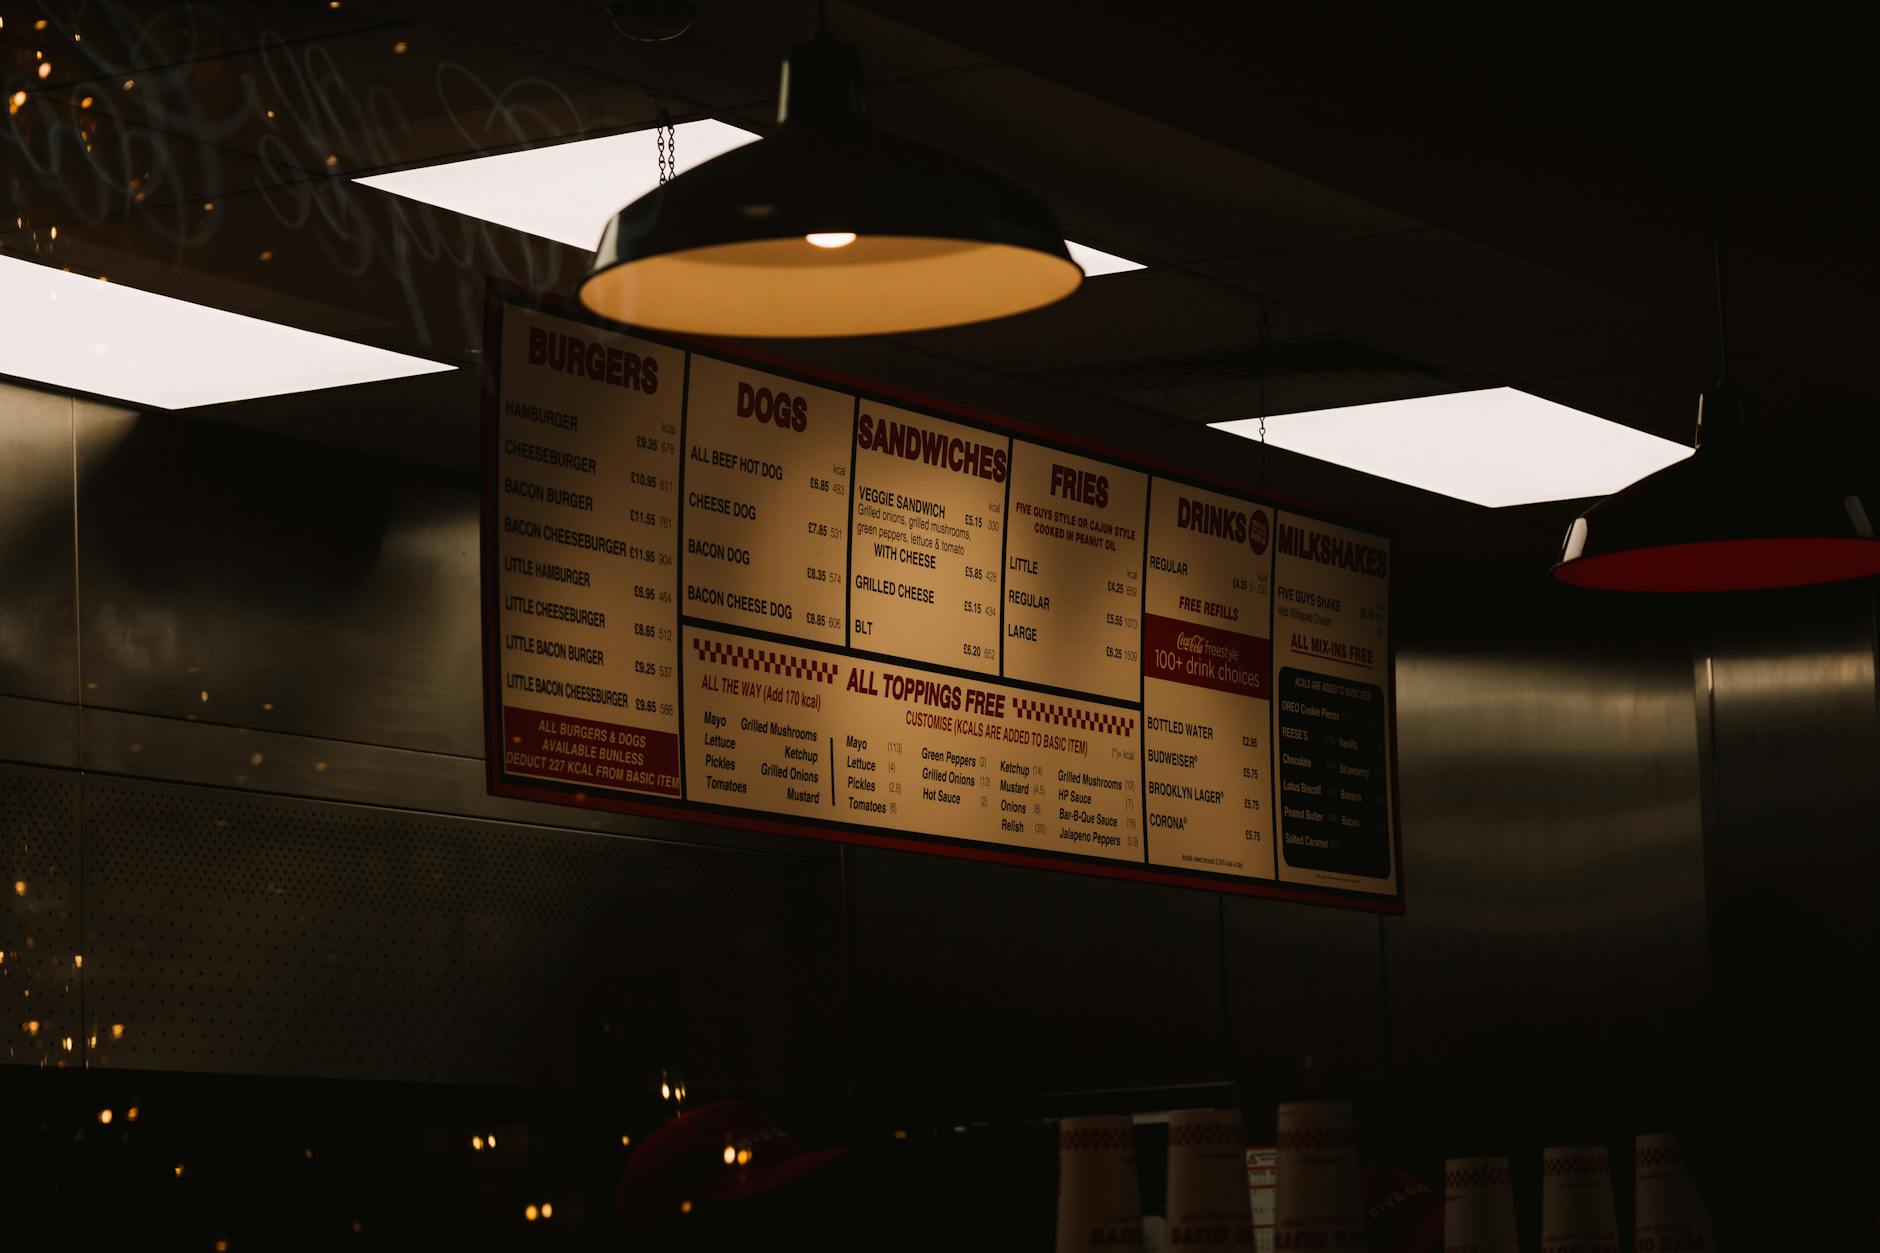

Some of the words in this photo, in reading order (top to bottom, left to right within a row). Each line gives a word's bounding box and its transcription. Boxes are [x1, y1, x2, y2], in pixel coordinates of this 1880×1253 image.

[529, 327, 658, 394] BURGERS
[505, 400, 577, 431] HAMBURGER
[737, 381, 807, 432] DOGS
[505, 439, 596, 474] CHEESEBURGER
[858, 414, 1006, 483] SANDWICHES
[691, 446, 709, 464] ALL
[712, 451, 737, 468] BEEF
[740, 456, 759, 474] HOT
[762, 462, 782, 480] DOG
[505, 478, 543, 500] BACON
[547, 488, 593, 511] BURGER
[1051, 464, 1108, 509] FRIES
[689, 492, 730, 515] CHEESE
[734, 503, 756, 520] DOG
[859, 485, 894, 507] VEGGIE
[897, 495, 945, 519] SANDWICH
[858, 504, 880, 519] Grilled
[883, 509, 906, 526] onions,
[908, 514, 929, 531] grilled
[931, 520, 971, 542] mushrooms,
[965, 514, 982, 528] £5.15
[1016, 503, 1032, 515] FIVE
[1034, 506, 1052, 520] GUYS
[1054, 511, 1076, 526] STYLE
[1078, 516, 1088, 529] OR
[1090, 519, 1112, 535] CAJUN
[1114, 524, 1135, 540] STYLE
[1178, 497, 1247, 544] DRINKS
[504, 517, 541, 539] BACON
[544, 525, 626, 556] CHEESEBURGER
[857, 522, 877, 537] green
[879, 526, 908, 544] peppers,
[911, 532, 932, 549] lettuce
[935, 538, 940, 549] &
[942, 539, 964, 556] tomato
[1034, 522, 1065, 540] COOKED
[1067, 529, 1074, 542] IN
[1076, 532, 1103, 549] PEANUT
[1106, 538, 1116, 551] OIL
[630, 547, 654, 562] £11.95
[688, 538, 724, 560] BACON
[728, 548, 750, 565] DOG
[874, 543, 897, 561] WITH
[900, 548, 936, 569] CHEESE
[1279, 524, 1386, 578] MILKSHAKES
[505, 556, 533, 576] LITTLE
[536, 563, 590, 587] HAMBURGER
[1010, 556, 1038, 574] LITTLE
[1150, 556, 1187, 576] REGULAR
[856, 575, 895, 595] GRILLED
[898, 583, 934, 604] CHEESE
[1108, 581, 1123, 594] £4.25
[1278, 586, 1293, 601] FIVE
[1296, 590, 1314, 606] GUYS
[1317, 594, 1340, 612] SHAKE
[688, 585, 723, 606] BACON
[727, 594, 767, 615] CHEESE
[771, 602, 792, 619] DOG
[1009, 589, 1050, 610] REGULAR
[1179, 596, 1201, 612] FREE
[1204, 600, 1238, 622] REFILLS
[505, 595, 533, 615] LITTLE
[536, 600, 605, 628] CHEESEBURGER
[856, 619, 872, 636] BLT
[1008, 624, 1037, 642] LARGE
[506, 634, 535, 653] LITTLE
[537, 639, 566, 659] BACON
[569, 646, 604, 666] BURGER
[964, 643, 980, 657] £6.20
[1205, 639, 1239, 662] freestyle
[1292, 633, 1308, 650] ALL
[1312, 637, 1346, 659] MIX-INS
[1350, 647, 1373, 664] FREE
[1155, 649, 1183, 671] 100+
[1186, 656, 1215, 680] drink
[1218, 664, 1260, 688] choices
[507, 672, 533, 691] LITTLE
[536, 678, 563, 697] BACON
[566, 682, 628, 708] CHEESEBURGER
[702, 674, 718, 692] ALL
[722, 678, 738, 695] THE
[742, 682, 761, 698] WAY
[764, 684, 783, 703] (Add
[786, 690, 799, 706] 170
[802, 692, 821, 712] kcal)
[847, 668, 877, 696] ALL
[883, 674, 961, 710] TOPPINGS
[966, 690, 1005, 718] FREE
[704, 712, 726, 728] Mayo
[1282, 701, 1299, 713] OREO
[1301, 704, 1319, 717] Cookie
[1321, 707, 1340, 721] Pieces
[538, 719, 556, 734] ALL
[560, 722, 607, 743] BURGERS
[609, 731, 616, 743] &
[618, 732, 646, 748] DOGS
[741, 718, 768, 733] Grilled
[770, 722, 817, 741] Mushrooms
[906, 711, 952, 732] CUSTOMISE
[954, 718, 983, 737] (KCALS
[986, 724, 1001, 740] ARE
[1004, 729, 1030, 746] ADDED
[1032, 733, 1041, 747] TO
[1043, 735, 1066, 751] BASIC
[1068, 738, 1088, 758] ITEM)
[1148, 717, 1183, 735] BOTTLED
[1186, 723, 1213, 740] WATER
[542, 738, 598, 759] AVAILABLE
[599, 746, 644, 766] BUNLESS
[705, 734, 735, 750] Lettuce
[846, 736, 867, 750] Mayo
[706, 754, 735, 770] Pickles
[785, 746, 818, 765] Ketchup
[847, 756, 876, 771] Lettuce
[922, 747, 944, 761] Green
[946, 752, 976, 767] Peppers
[1283, 753, 1312, 767] Chocolate
[506, 752, 546, 769] DEDUCT
[550, 758, 565, 771] 227
[568, 760, 593, 776] KCAL
[596, 764, 624, 781] FROM
[627, 769, 654, 785] BASIC
[658, 774, 680, 789] ITEM
[761, 763, 787, 778] Grilled
[790, 768, 818, 783] Onions
[922, 768, 946, 782] Grilled
[949, 772, 975, 787] Onions
[1000, 760, 1030, 776] Ketchup
[707, 776, 747, 793] Tomatoes
[848, 777, 876, 791] Pickles
[1000, 780, 1029, 795] Mustard
[1058, 770, 1080, 784] Grilled
[1082, 775, 1122, 791] Mushrooms
[787, 788, 819, 804] Mustard
[849, 797, 886, 813] Tomatoes
[923, 788, 936, 801] Hot
[938, 790, 961, 804] Sauce
[1001, 800, 1026, 814] Onions
[1058, 789, 1069, 801] HP
[1070, 791, 1092, 804] Sauce
[1059, 809, 1095, 824] Bar-B-Que
[1097, 814, 1118, 827] Sauce
[1285, 807, 1304, 820] Peanut
[1305, 810, 1323, 822] Butter
[1001, 820, 1023, 833] Relish
[1285, 833, 1304, 846] Salted
[1305, 836, 1328, 848] Caramel
